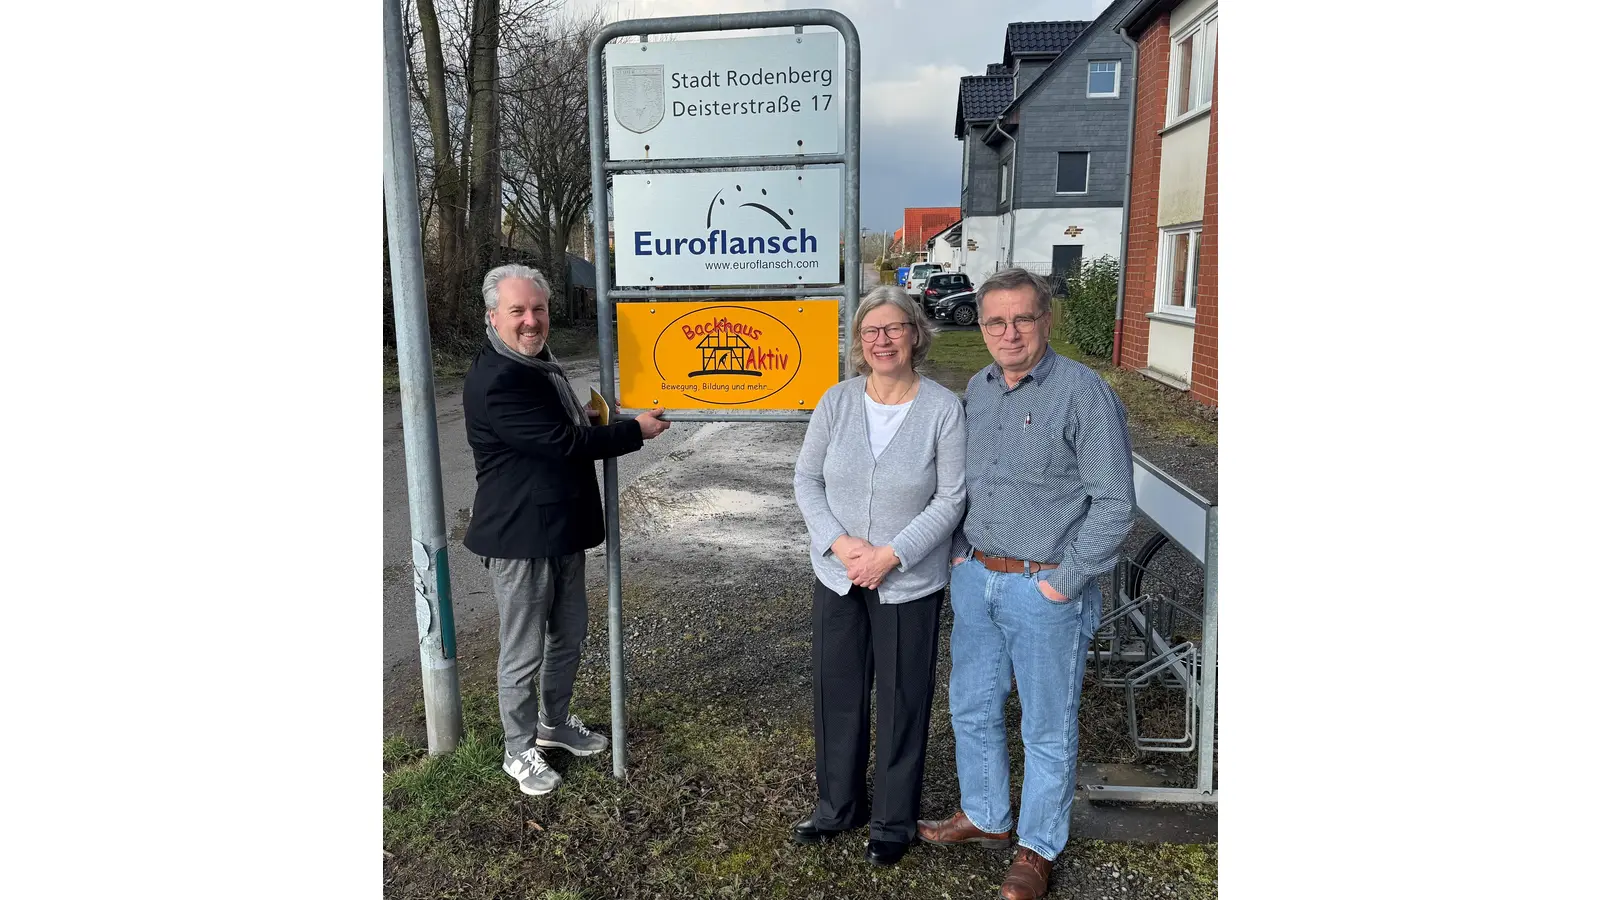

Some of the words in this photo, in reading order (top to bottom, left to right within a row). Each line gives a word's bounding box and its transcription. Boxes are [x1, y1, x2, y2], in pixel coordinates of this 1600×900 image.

[671, 71, 720, 89] Stadt
[727, 66, 833, 87] Rodenberg
[672, 95, 801, 117] Deisterstraße
[811, 94, 832, 111] 17
[634, 228, 817, 256] Euroflansch
[705, 259, 819, 270] www.euroflansch.com
[681, 317, 762, 340] Backhaus
[746, 347, 788, 370] Aktiv
[661, 382, 700, 392] Bewegung,
[702, 382, 730, 392] Bildung
[732, 382, 745, 391] und
